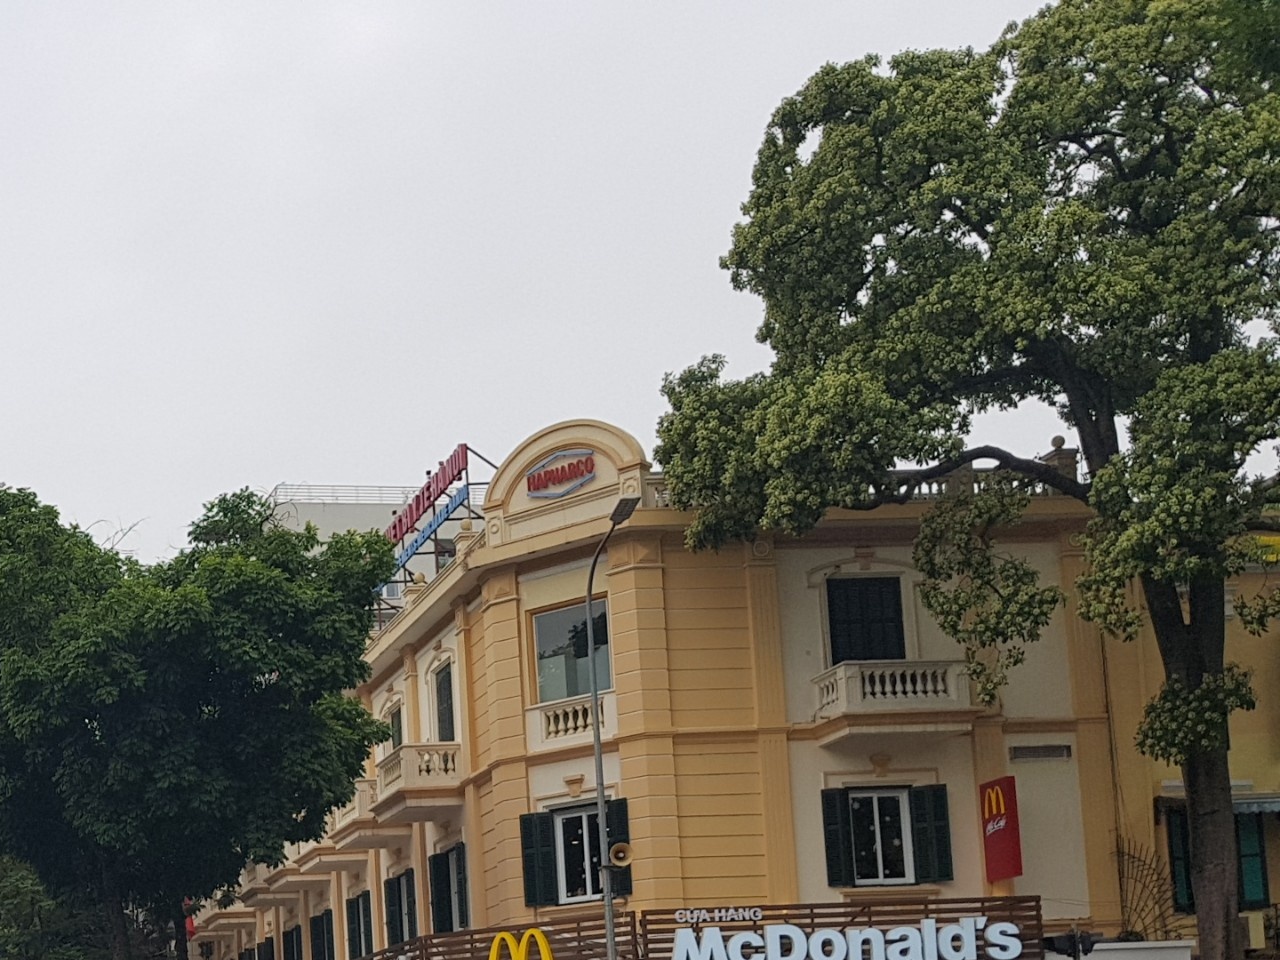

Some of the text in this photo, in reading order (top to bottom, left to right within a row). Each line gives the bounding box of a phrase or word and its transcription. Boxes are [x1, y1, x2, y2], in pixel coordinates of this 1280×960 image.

[527, 456, 595, 492] HAPHARCO
[674, 905, 763, 923] CỬA HÀNG
